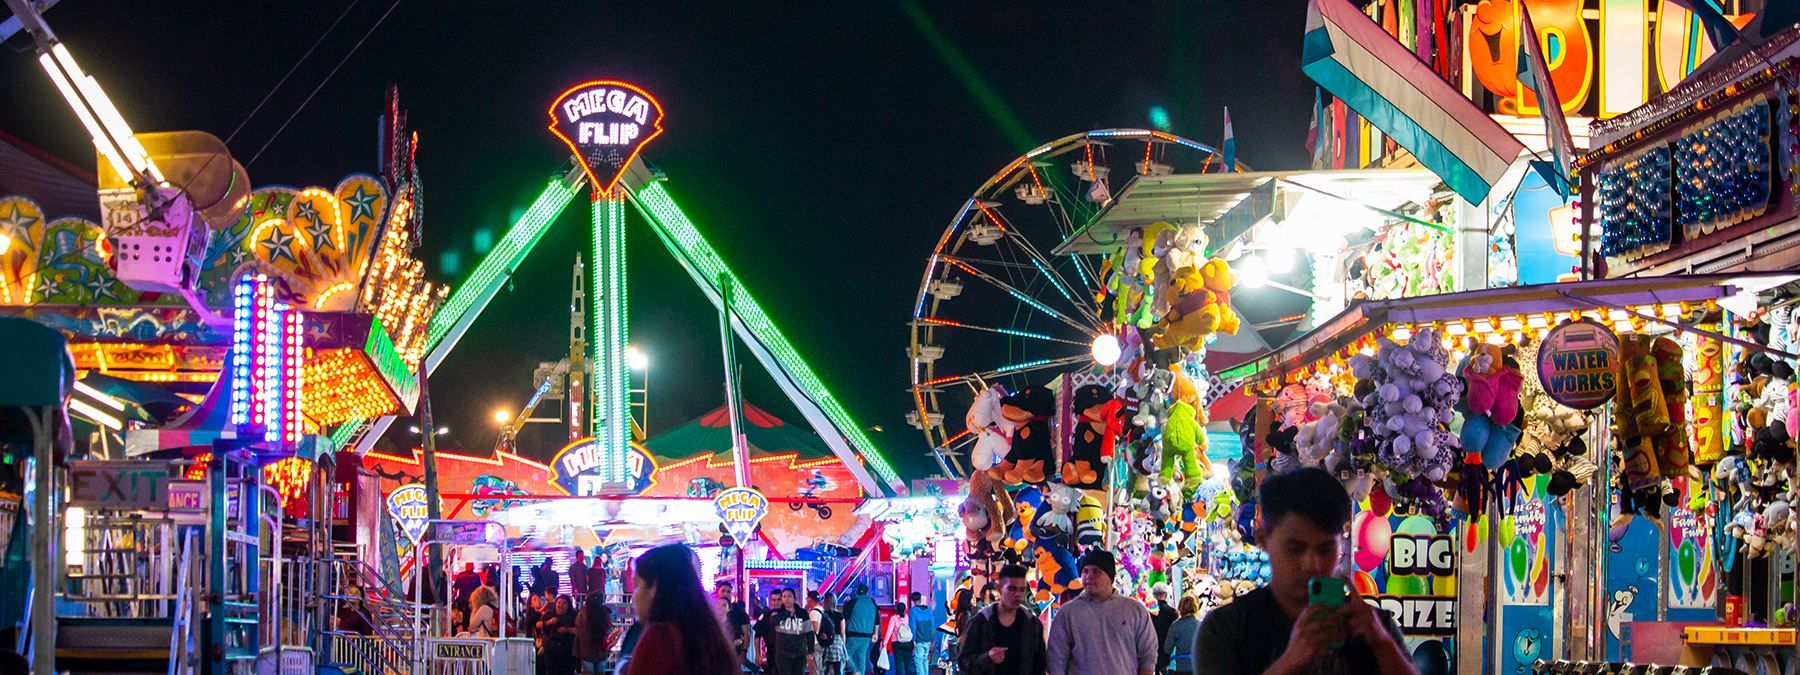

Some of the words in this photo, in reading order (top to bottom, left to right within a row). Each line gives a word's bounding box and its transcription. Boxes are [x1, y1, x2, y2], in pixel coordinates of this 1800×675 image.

[1516, 0, 1712, 119] BI
[563, 88, 649, 125] MEGA
[578, 122, 639, 145] FLIP
[116, 212, 133, 224] 14
[1551, 350, 1609, 372] WATER
[1549, 371, 1615, 394] WORKS
[562, 444, 644, 479] MEA
[72, 470, 168, 502] EXIT
[168, 491, 199, 508] ANCE
[719, 493, 760, 510] MEGA
[727, 509, 756, 521] FLIP
[1508, 509, 1546, 526] amily
[1514, 524, 1538, 536] Fun
[1682, 527, 1705, 539] Fun
[1393, 537, 1452, 570] BIG
[1362, 598, 1457, 629] RIZE
[779, 615, 804, 635] LOVE
[438, 644, 483, 658] ENTRANCE
